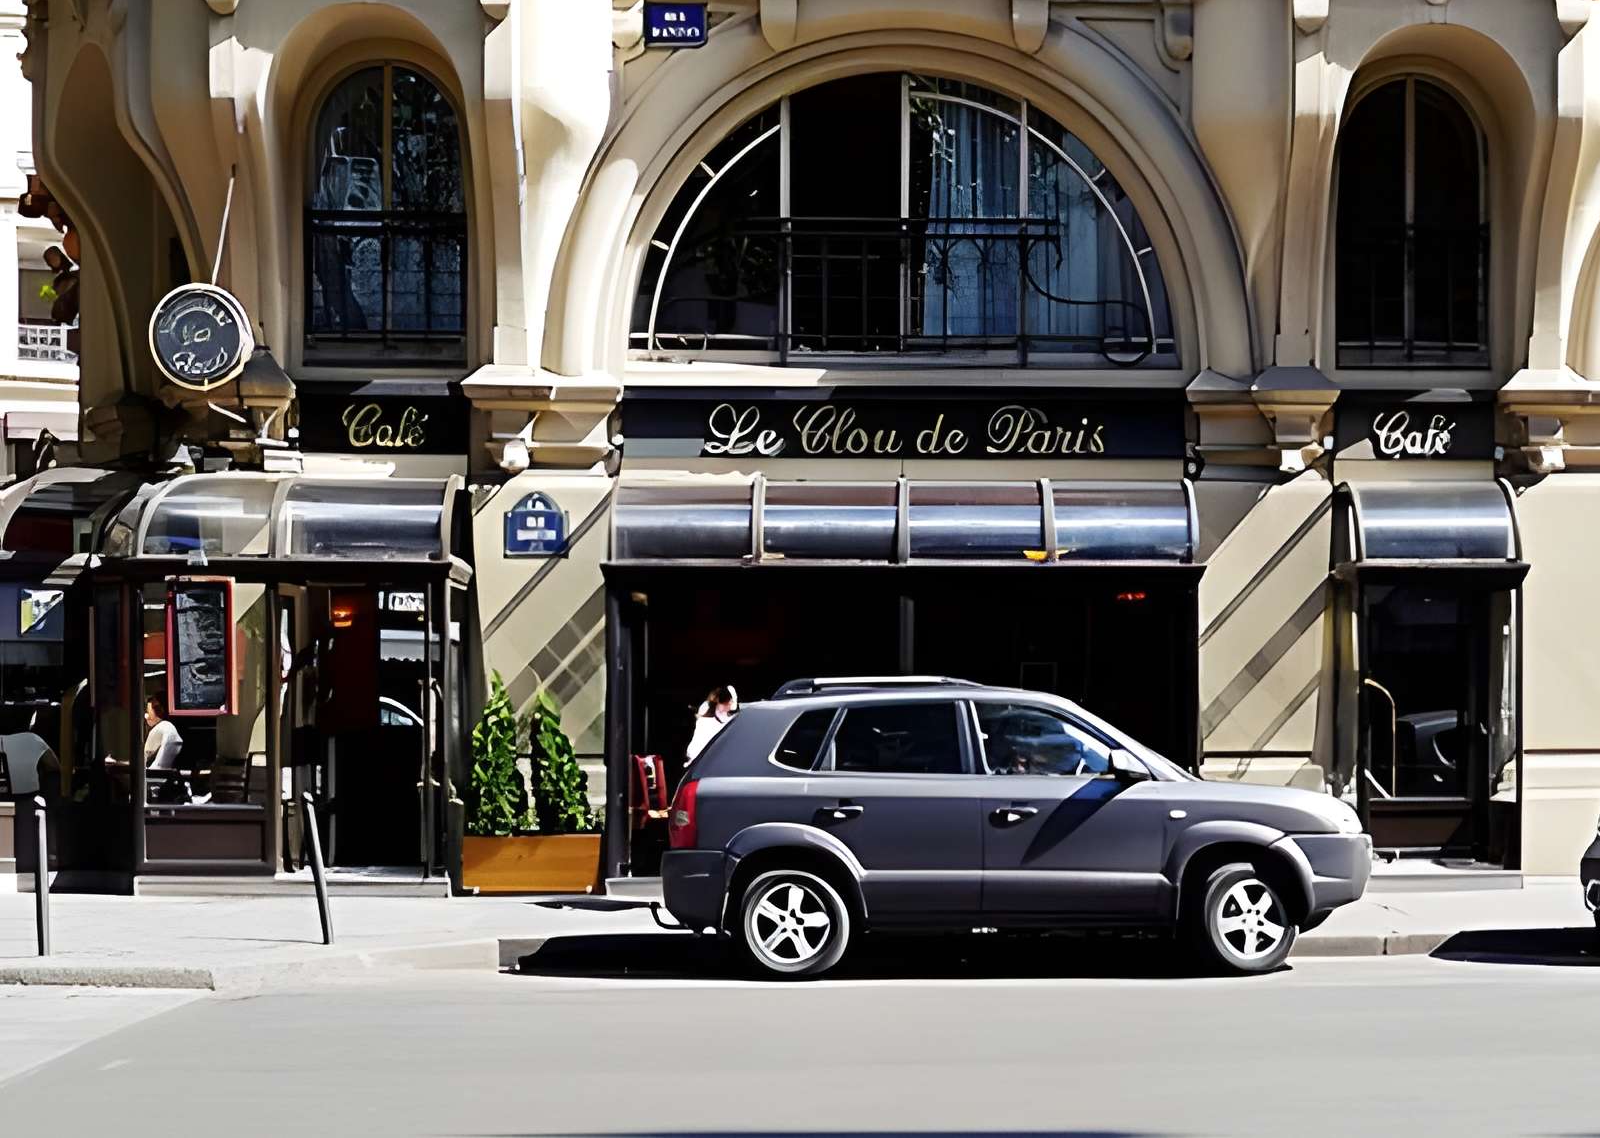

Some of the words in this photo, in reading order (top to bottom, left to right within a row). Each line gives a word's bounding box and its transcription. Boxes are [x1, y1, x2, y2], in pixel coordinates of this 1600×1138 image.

[341, 403, 429, 448] Café
[703, 403, 787, 456] Le
[792, 405, 903, 454] Clou
[916, 413, 969, 454] de
[986, 404, 1105, 454] Paris
[1372, 410, 1457, 457] Café
